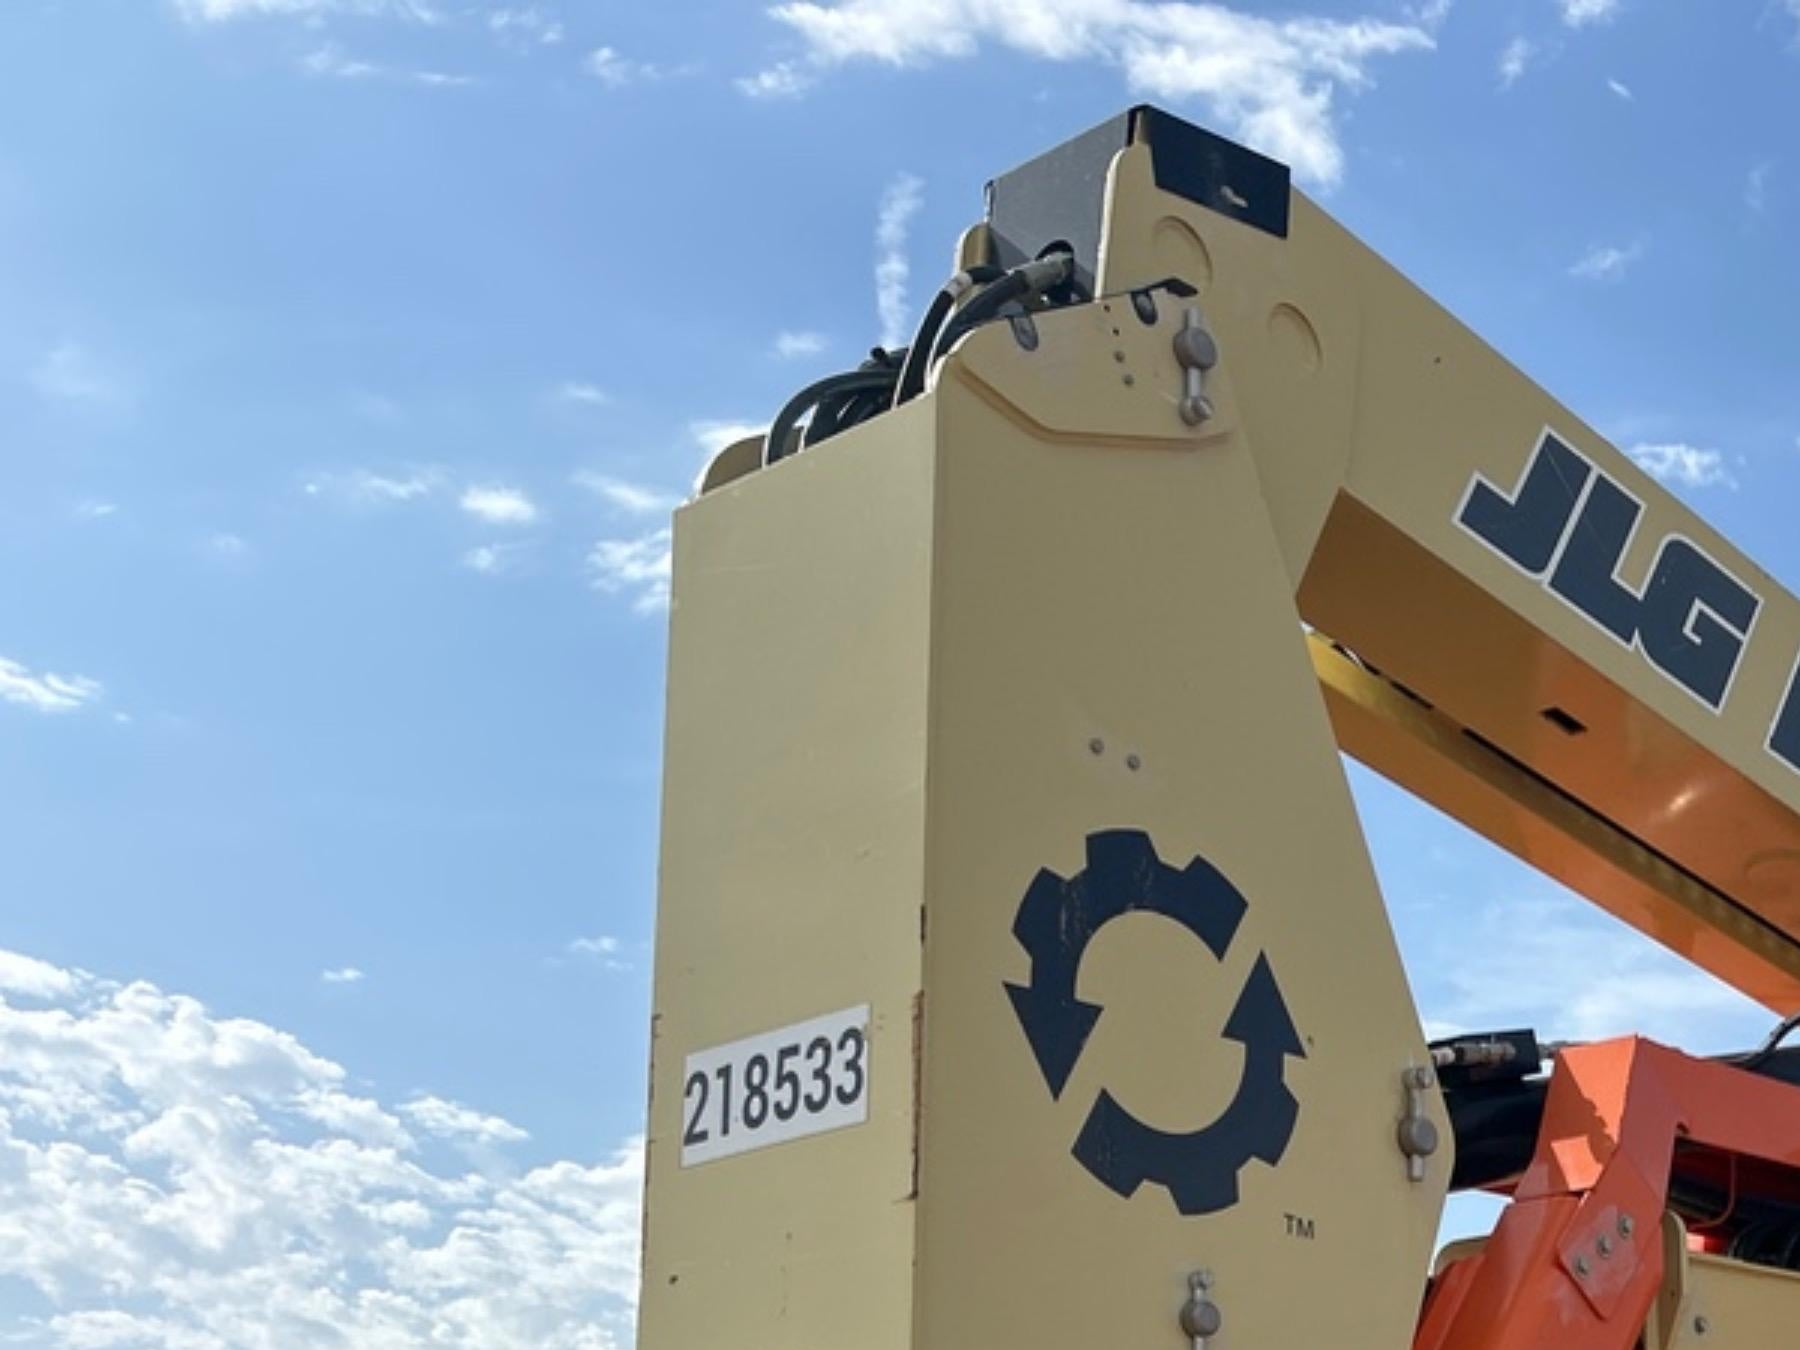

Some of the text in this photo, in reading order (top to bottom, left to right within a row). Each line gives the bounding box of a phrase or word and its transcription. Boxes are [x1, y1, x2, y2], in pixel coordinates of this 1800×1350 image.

[1452, 425, 1763, 716] JLG
[683, 1026, 865, 1146] 218533
[1283, 1211, 1315, 1240] TM
